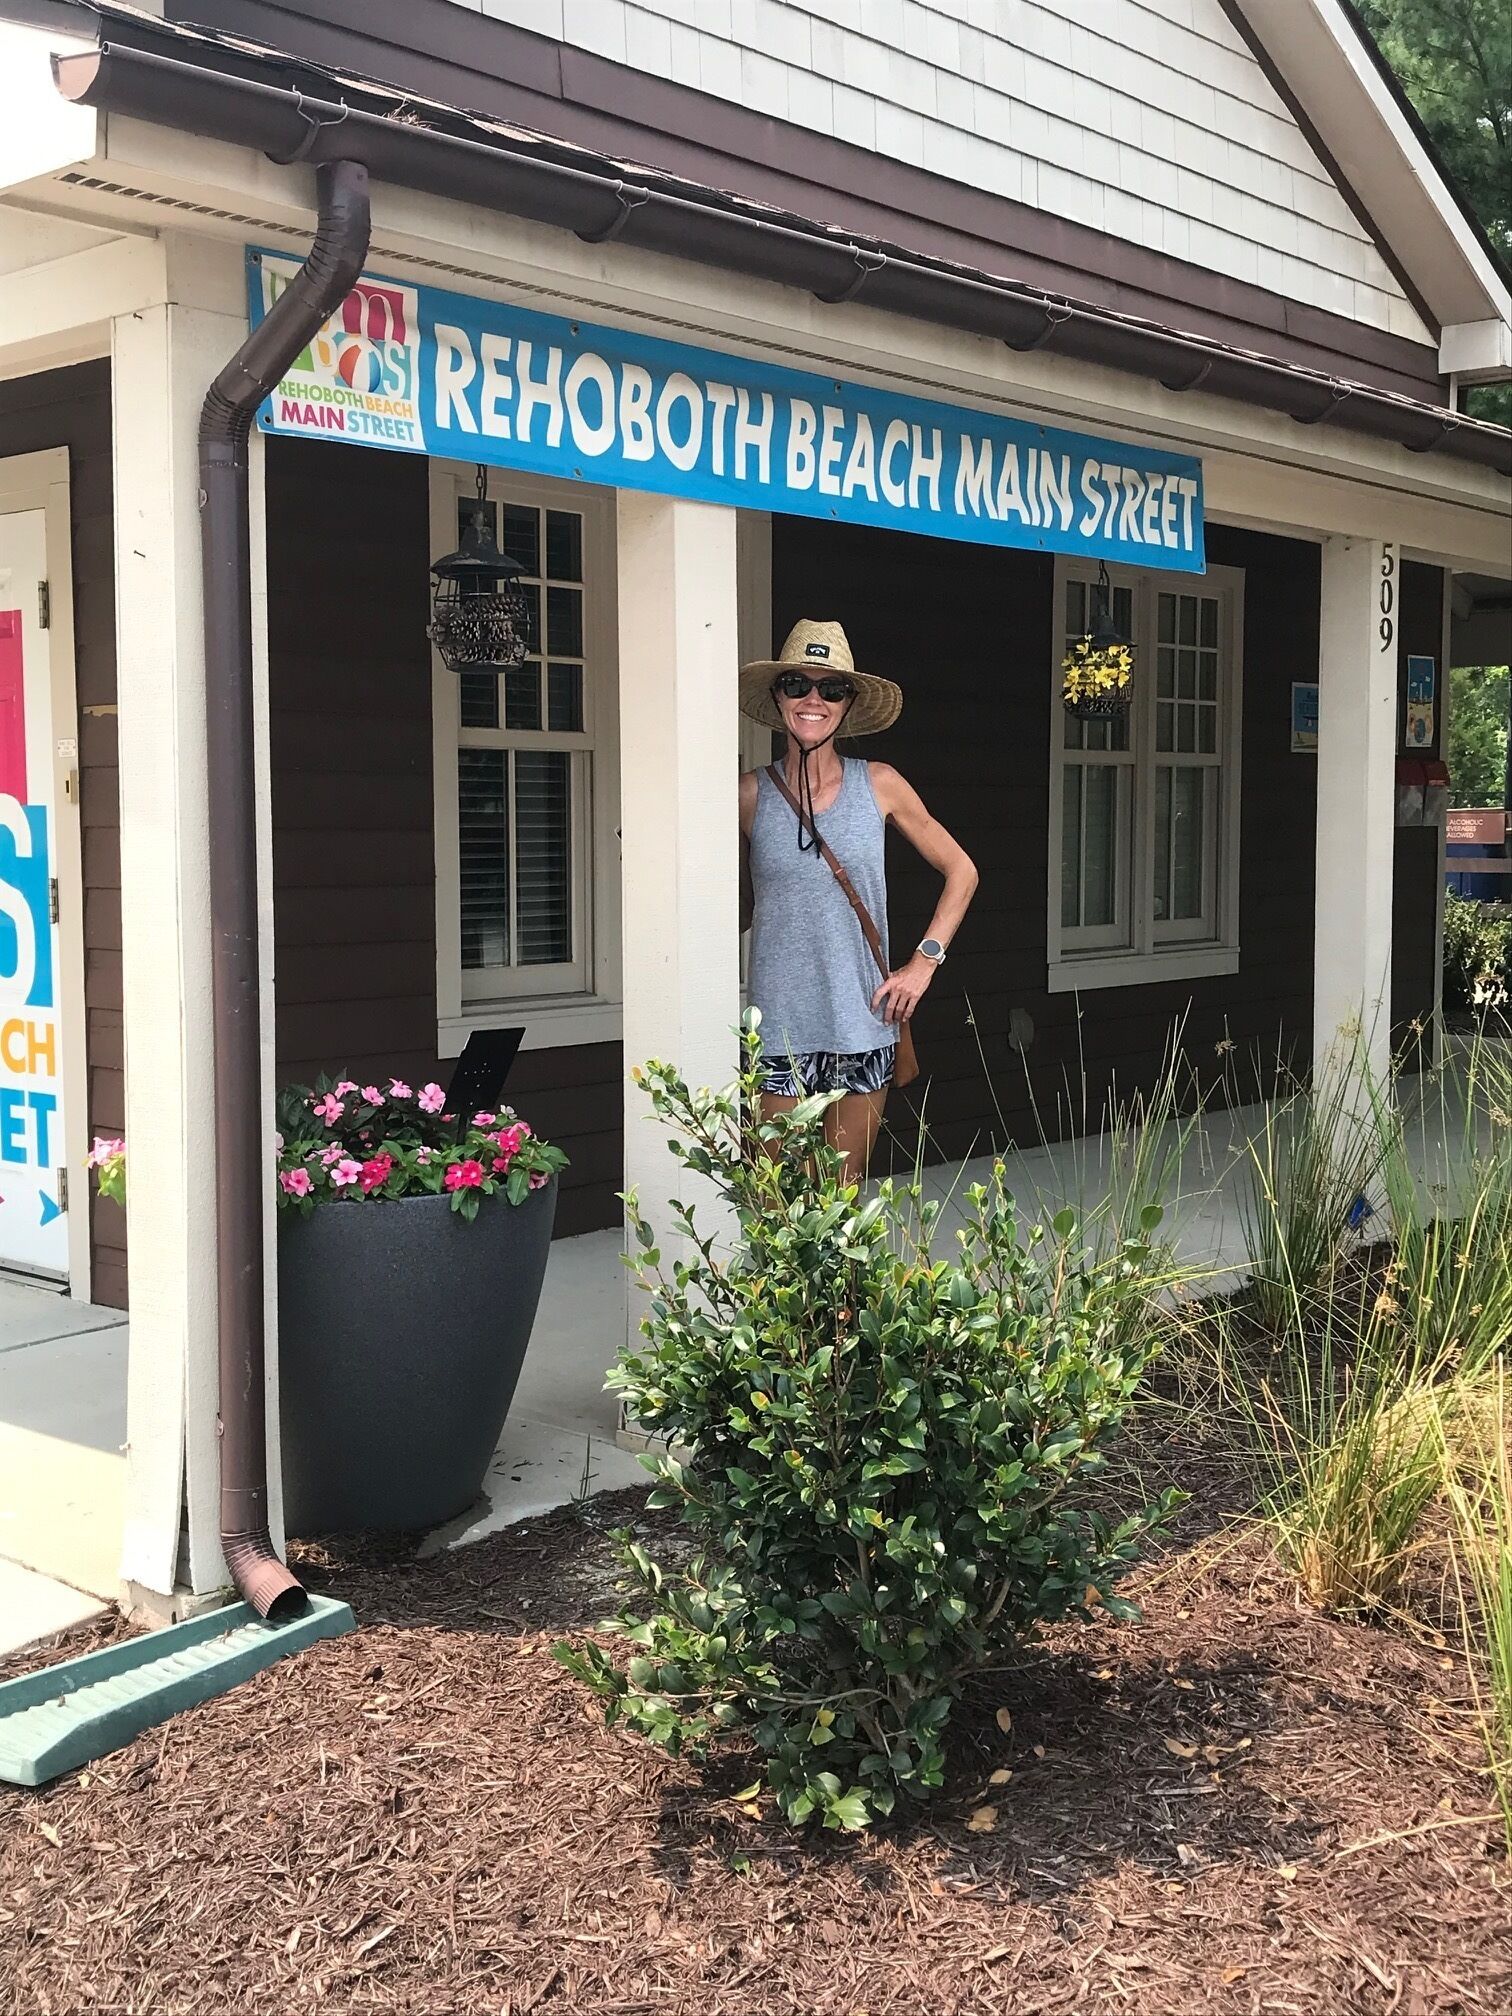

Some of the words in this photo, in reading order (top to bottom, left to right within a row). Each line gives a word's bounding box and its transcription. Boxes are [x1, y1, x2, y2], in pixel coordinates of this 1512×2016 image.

[278, 382, 364, 409] REHOBOTH
[365, 396, 413, 419] BEACH
[281, 400, 345, 431] MAIN
[347, 411, 415, 442] STREET
[434, 322, 775, 485] REHOBOTH
[786, 398, 943, 512] BEACH
[954, 434, 1074, 532] MAIN
[1079, 458, 1198, 551] STREET
[1380, 542, 1394, 653] 509
